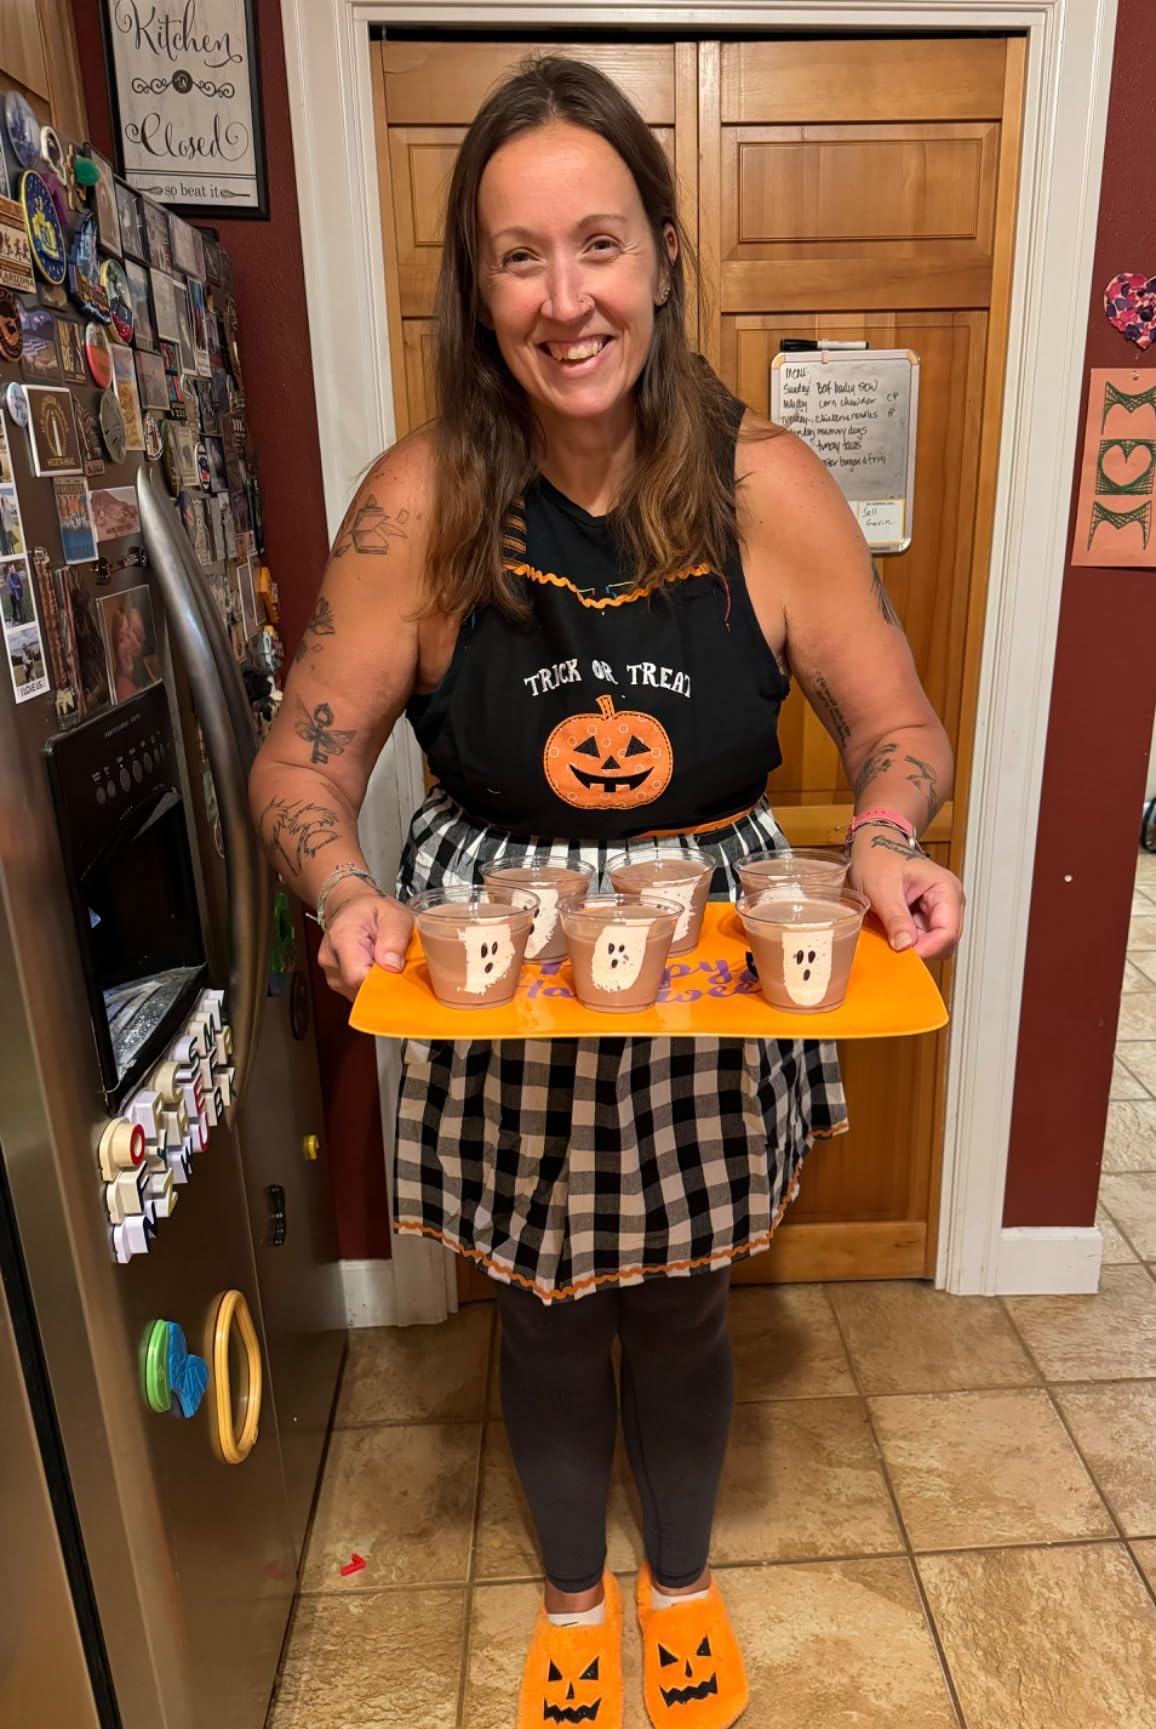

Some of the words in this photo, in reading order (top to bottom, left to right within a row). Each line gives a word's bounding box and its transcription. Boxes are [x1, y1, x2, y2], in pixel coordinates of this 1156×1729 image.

[115, 0, 243, 68] Kitchen
[125, 113, 248, 161] Closed
[165, 186, 177, 197] so
[180, 182, 206, 197] beat
[210, 186, 219, 198] it
[524, 658, 582, 696] TRICK
[591, 659, 618, 685] OR
